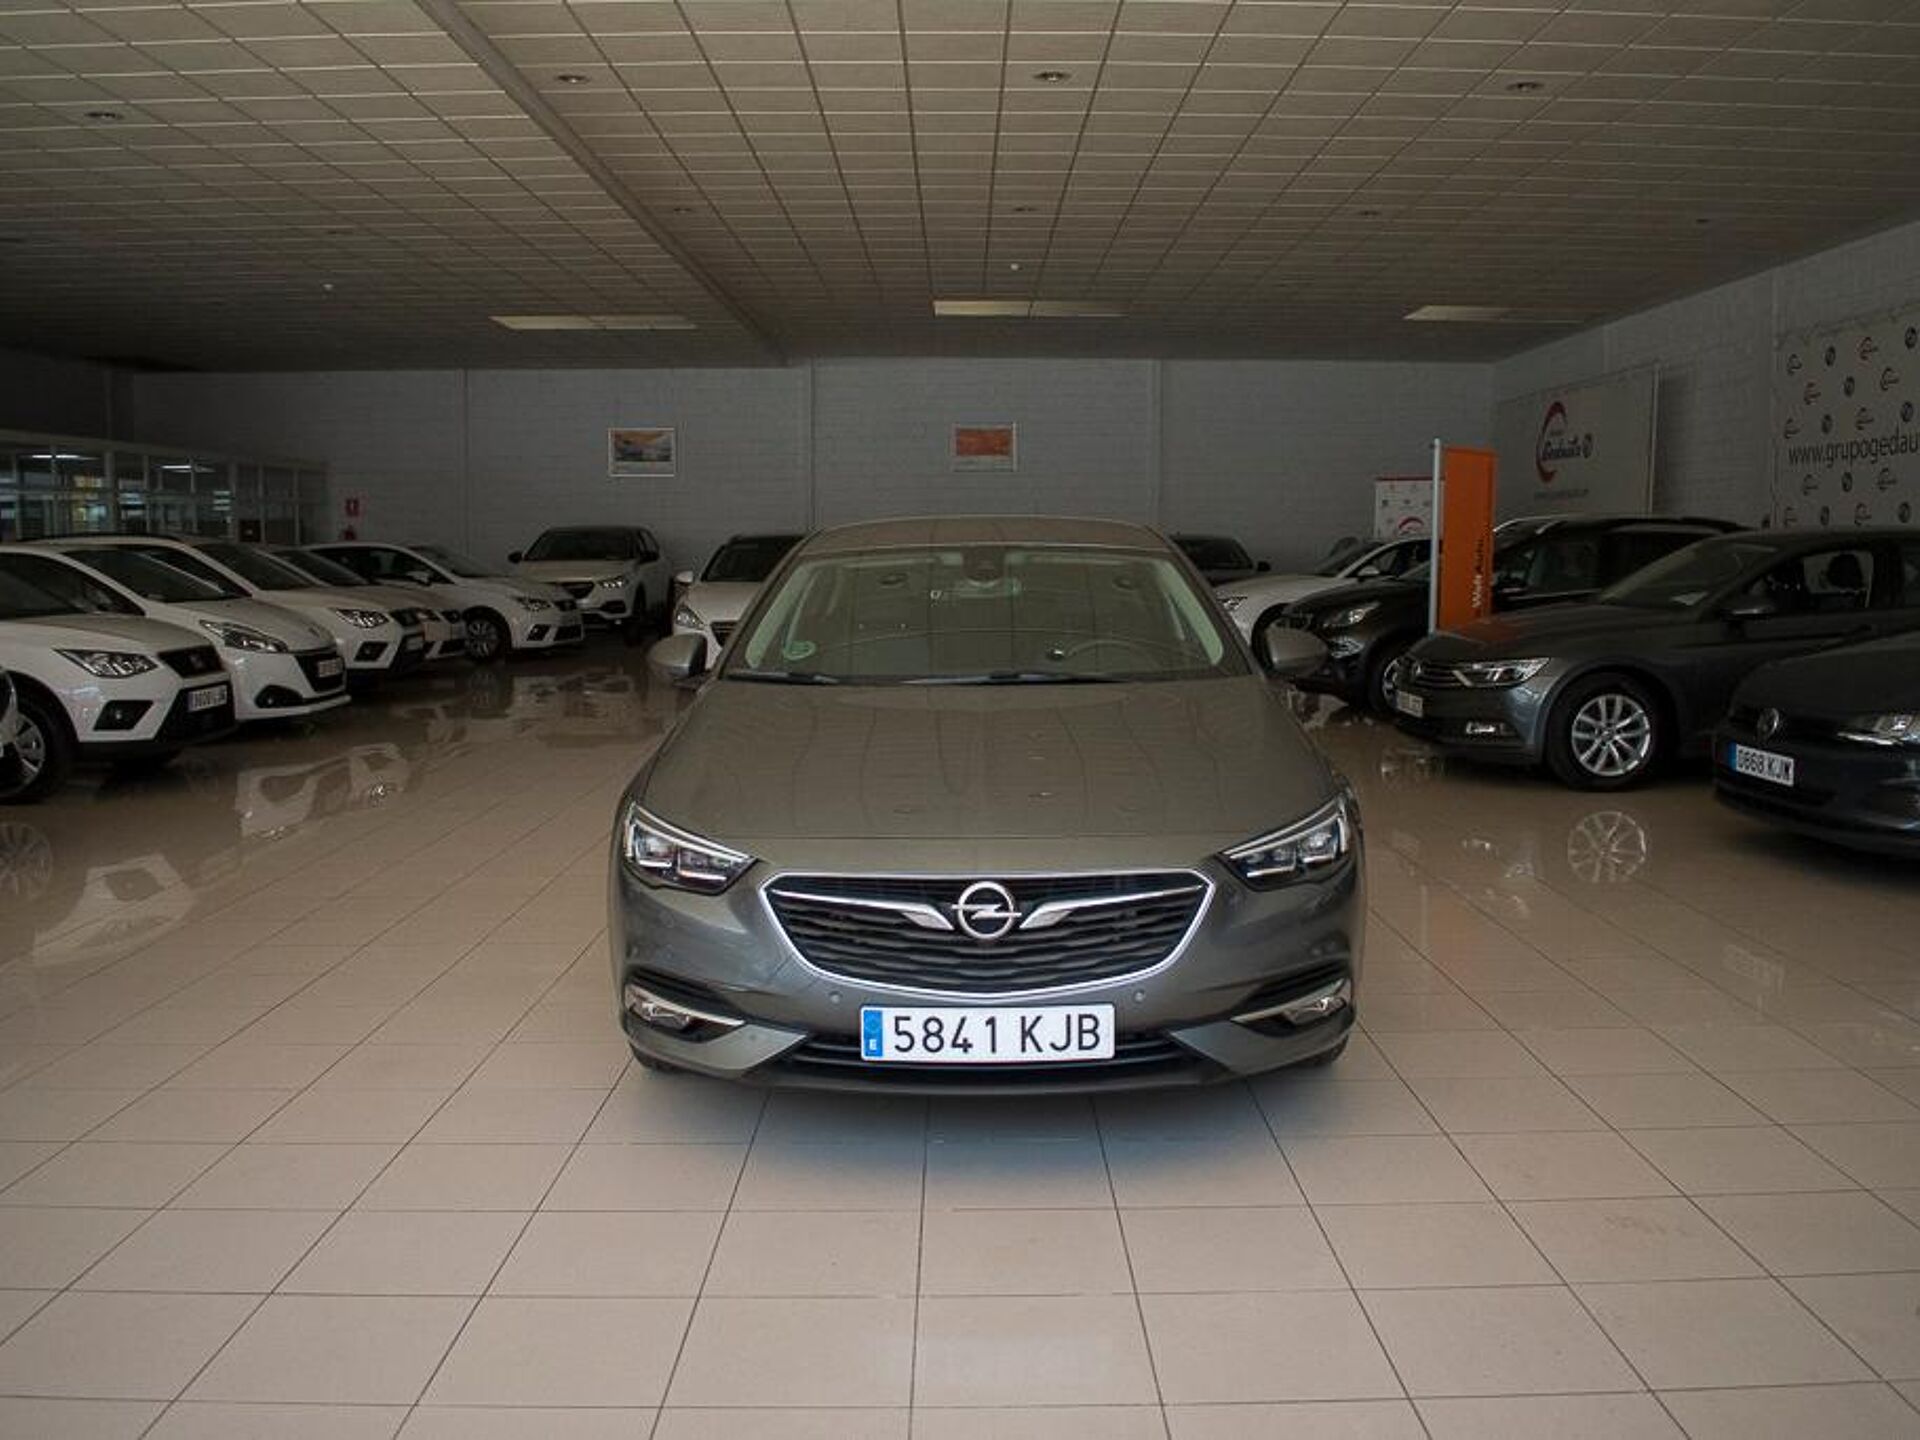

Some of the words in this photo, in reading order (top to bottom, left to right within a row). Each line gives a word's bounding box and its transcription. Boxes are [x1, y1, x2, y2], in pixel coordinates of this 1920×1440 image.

[1788, 423, 1920, 467] www.grupogedau
[893, 1016, 998, 1054] 5841
[1020, 1014, 1101, 1053] KJB
